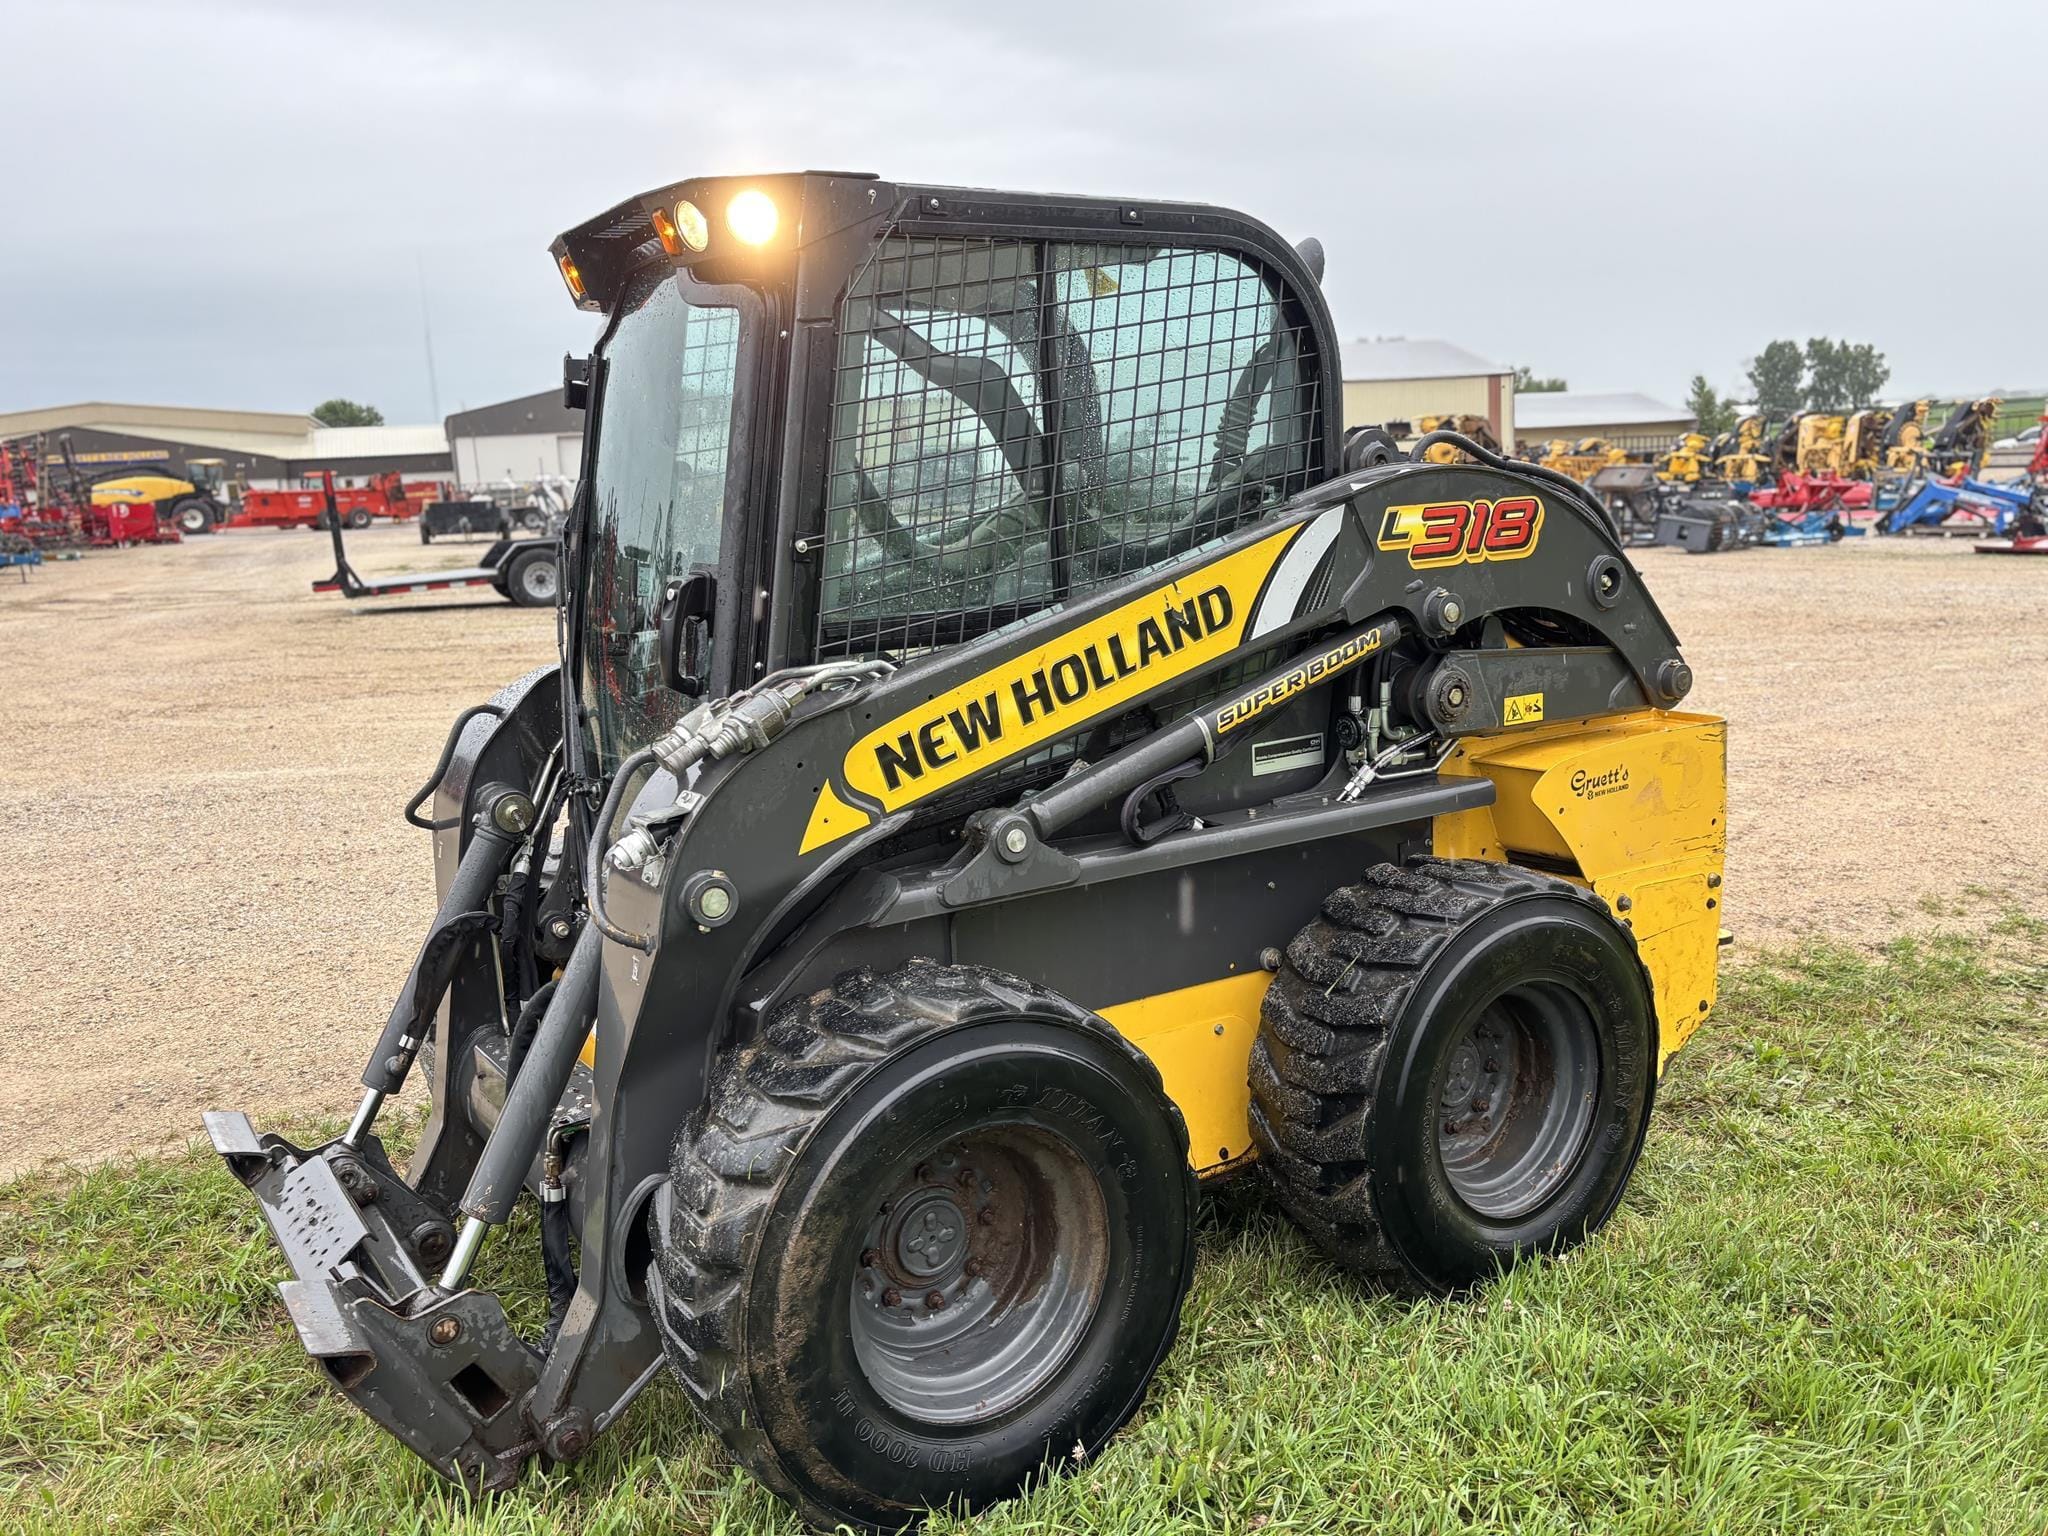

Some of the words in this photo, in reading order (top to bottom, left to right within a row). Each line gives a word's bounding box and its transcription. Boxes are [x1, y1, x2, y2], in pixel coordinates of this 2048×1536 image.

[1379, 498, 1542, 565] L318
[874, 690, 1003, 792] NEW
[1010, 584, 1234, 727] HOLLAND
[1218, 671, 1305, 732] SUPER
[1307, 629, 1381, 684] BOOM
[1571, 763, 1629, 797] Gruett's
[1594, 789, 1606, 798] NEW
[1606, 783, 1630, 795] HOLLAND
[1034, 1086, 1127, 1146] TITAN
[854, 1416, 921, 1469] 2000
[928, 1446, 975, 1474] HD
